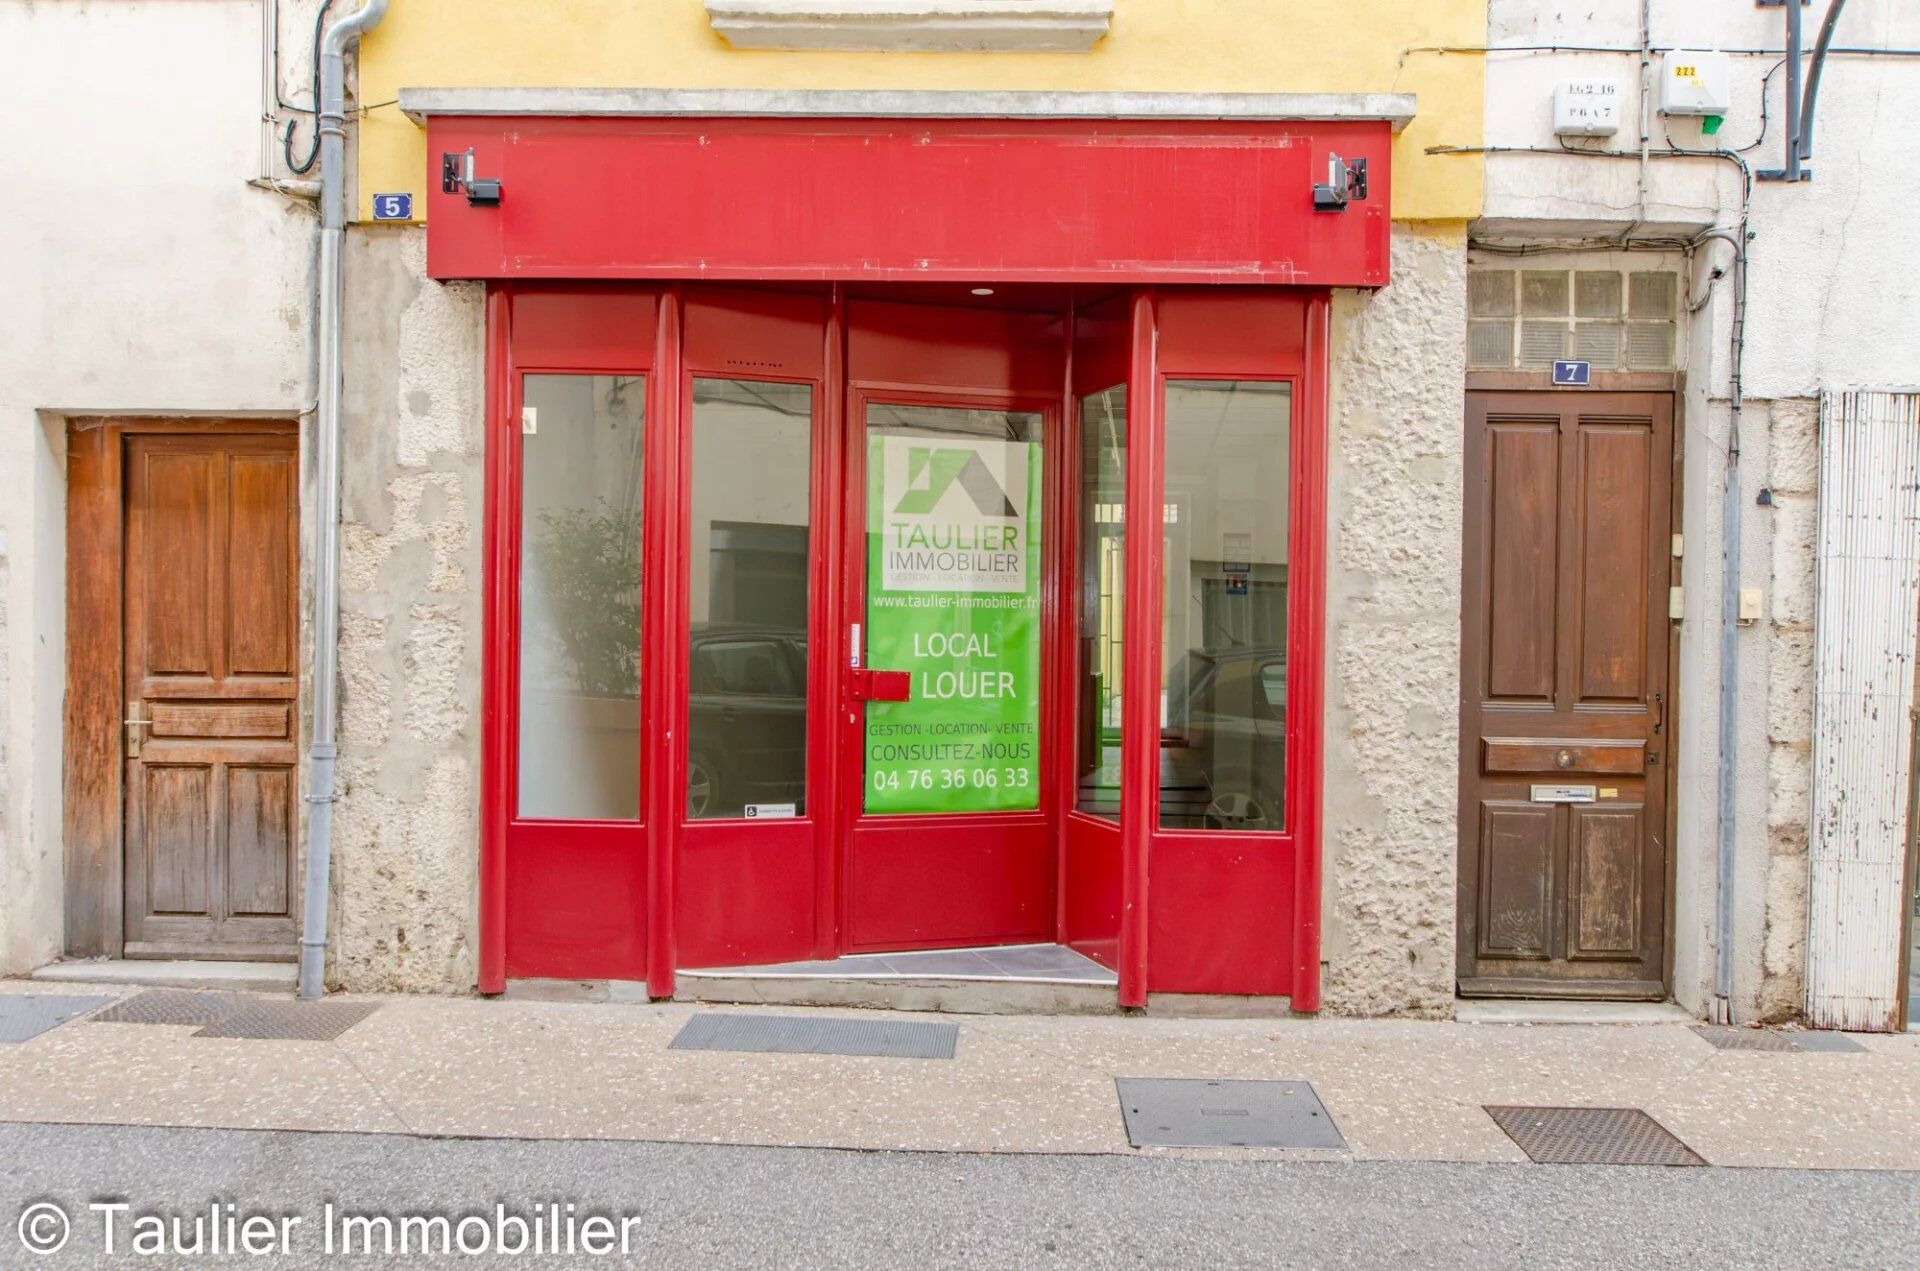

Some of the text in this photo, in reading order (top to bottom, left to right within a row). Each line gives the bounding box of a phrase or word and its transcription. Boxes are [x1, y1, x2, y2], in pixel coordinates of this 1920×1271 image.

[385, 197, 400, 217] 5
[1565, 364, 1578, 381] 7
[891, 522, 1018, 551] TAULIER
[890, 551, 1018, 572] IMMOBILIER
[873, 594, 1038, 609] www.taulier-immobilier.fr
[914, 633, 997, 657] LOCAL
[922, 672, 1017, 698] LOUER
[869, 724, 921, 736] GESTION
[996, 722, 1034, 734] VENTE
[871, 743, 1031, 761] CONSULTEZ-NOUS
[873, 768, 1029, 791] 04 76 36 06 33
